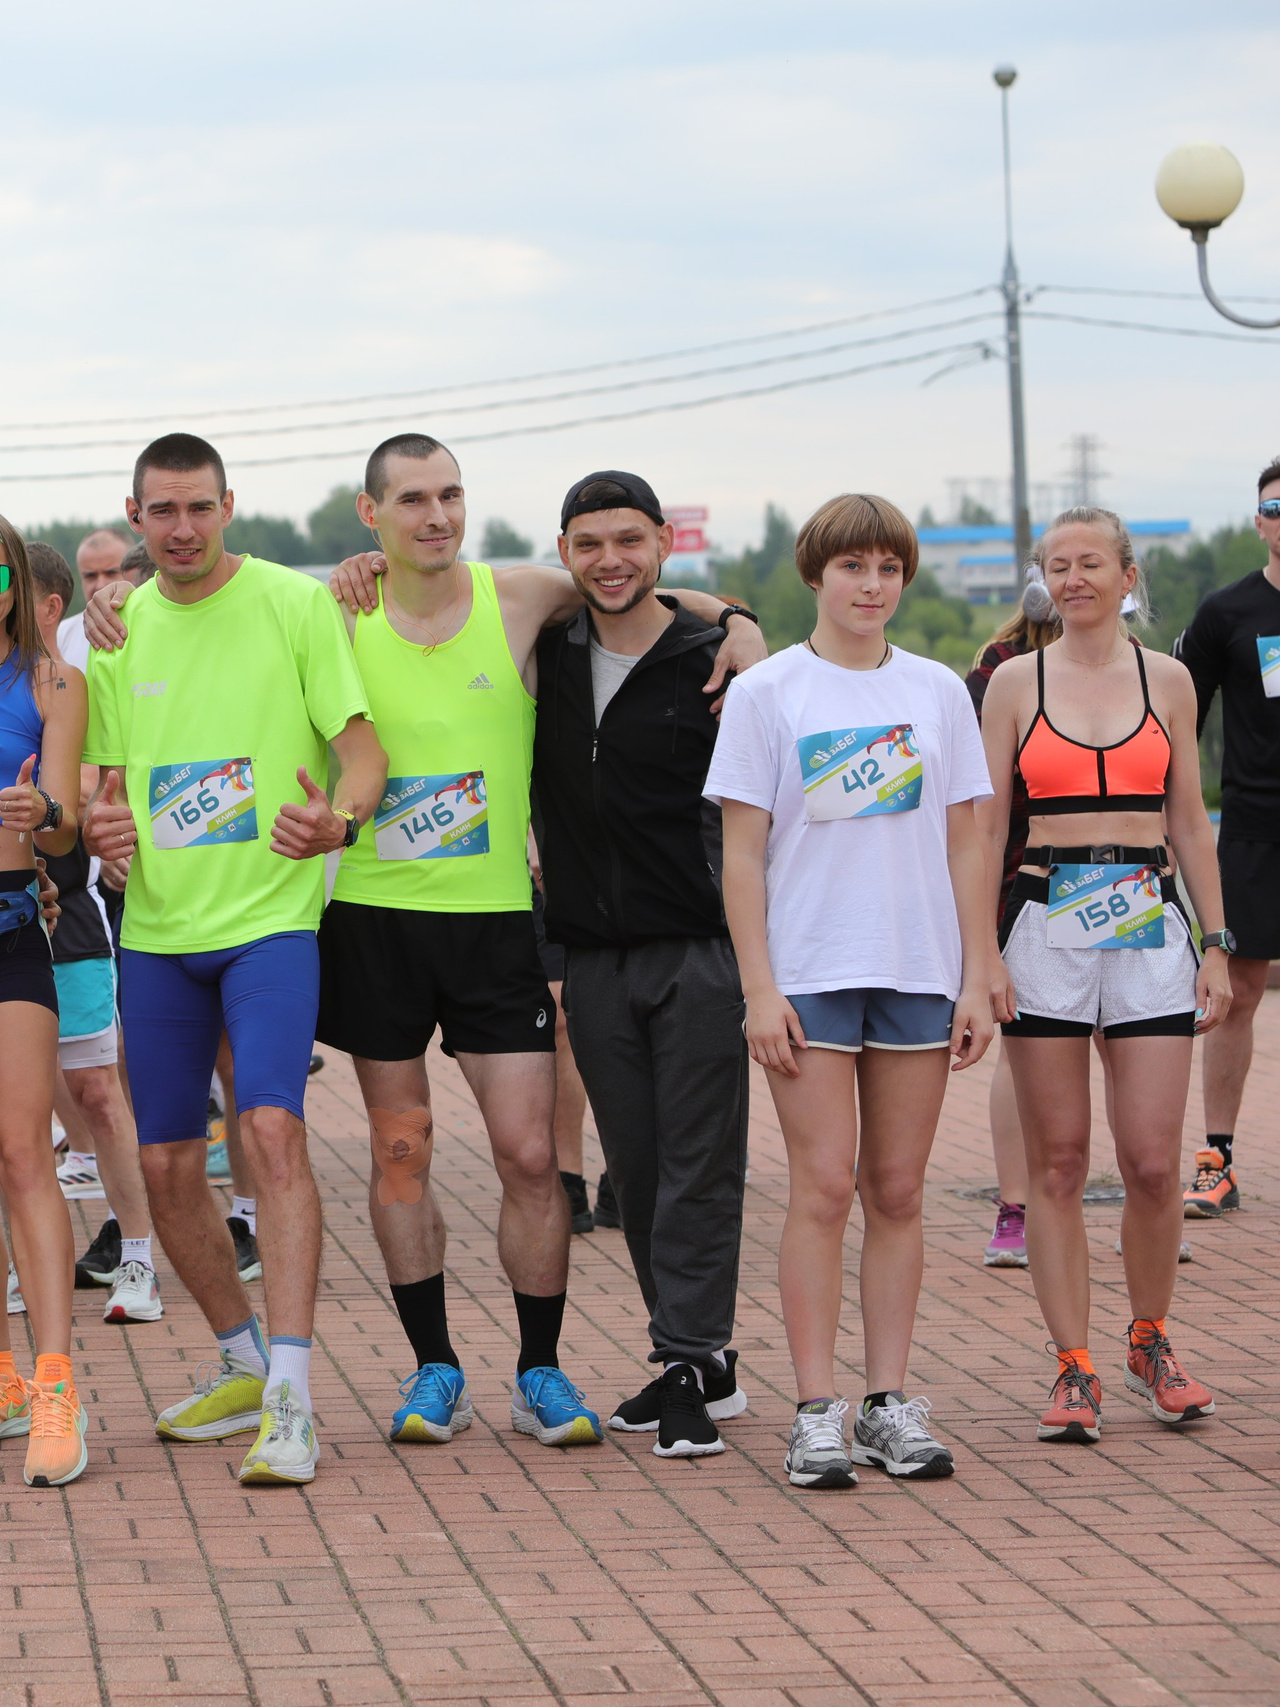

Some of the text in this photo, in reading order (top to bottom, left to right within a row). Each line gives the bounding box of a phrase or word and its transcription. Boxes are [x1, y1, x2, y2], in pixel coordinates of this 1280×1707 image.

[842, 758, 885, 794] 42
[884, 775, 907, 793] КЛИН
[170, 788, 220, 831] 166
[214, 808, 238, 825] КЛИН
[399, 801, 455, 844] 146
[449, 821, 472, 839] КЛИН
[1074, 893, 1130, 932] 158
[1124, 915, 1148, 930] КЛИН
